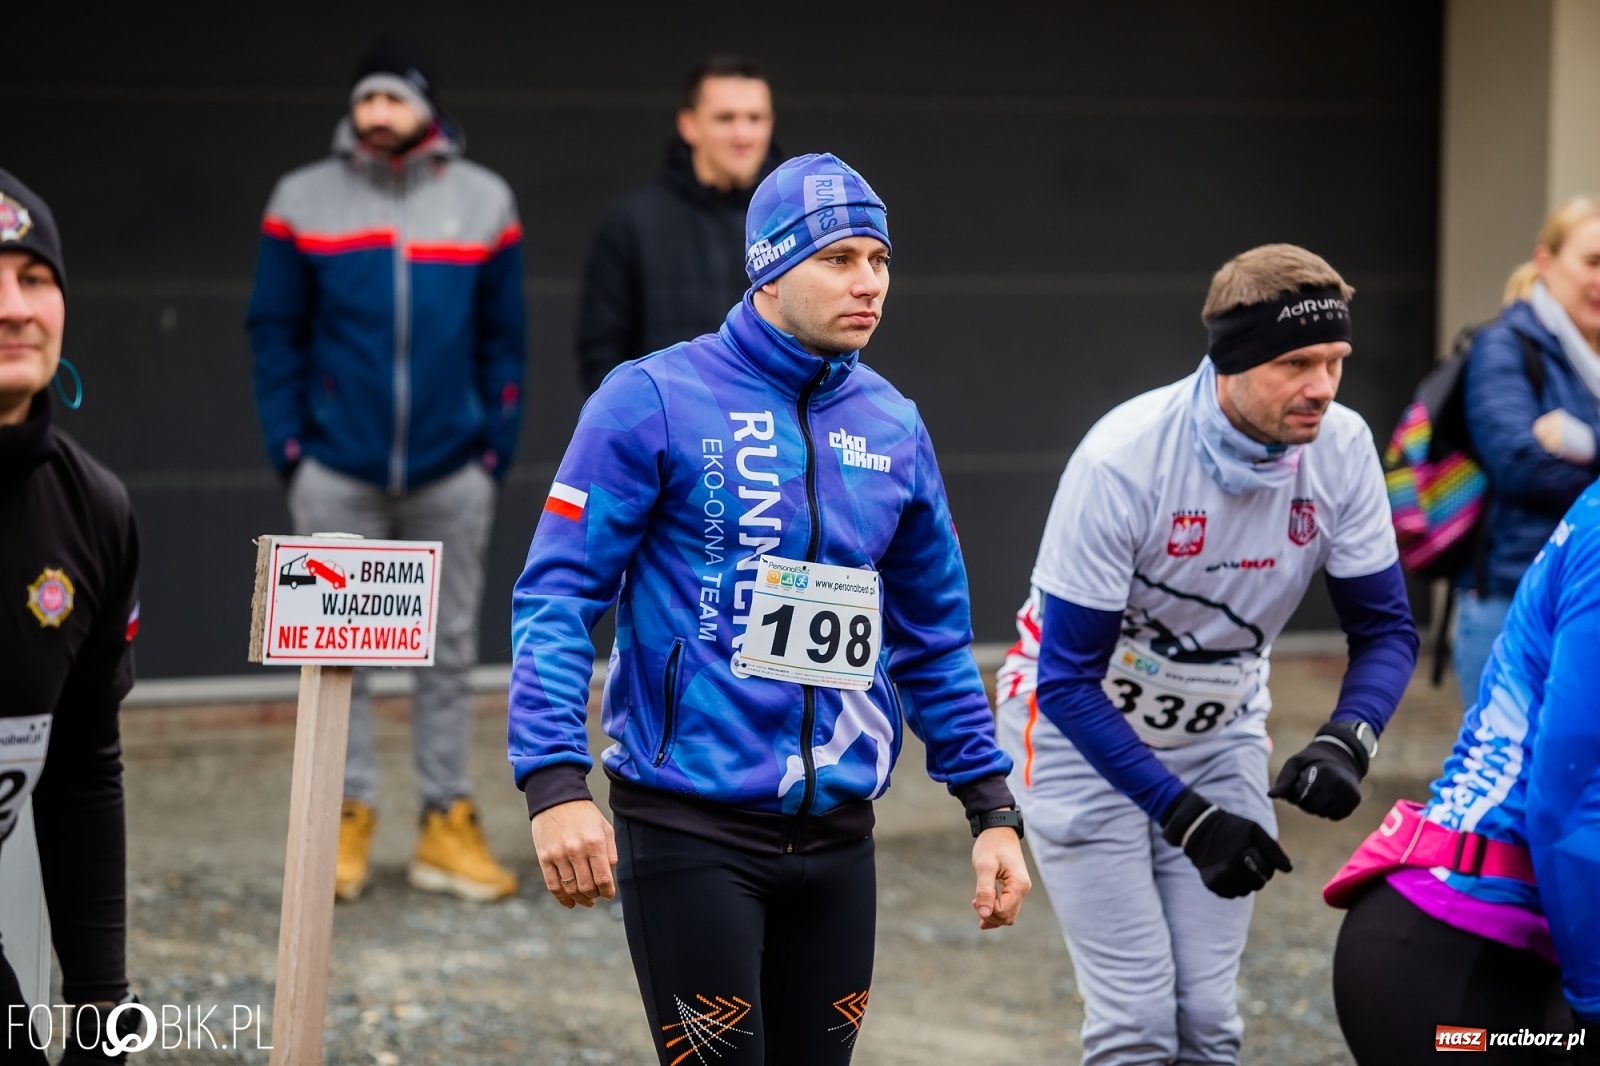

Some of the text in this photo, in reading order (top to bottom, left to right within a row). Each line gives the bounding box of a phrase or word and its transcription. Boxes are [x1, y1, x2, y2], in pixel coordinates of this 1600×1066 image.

[698, 438, 725, 642] EKO-OKNA TEAM
[360, 561, 424, 584] BRAMA
[815, 580, 876, 596] www.personalbest.pl
[322, 593, 422, 616] WJAZDOWA
[278, 620, 421, 650] NIE ZASTAWIAĆ
[761, 604, 872, 668] 198
[1112, 678, 1225, 734] 338
